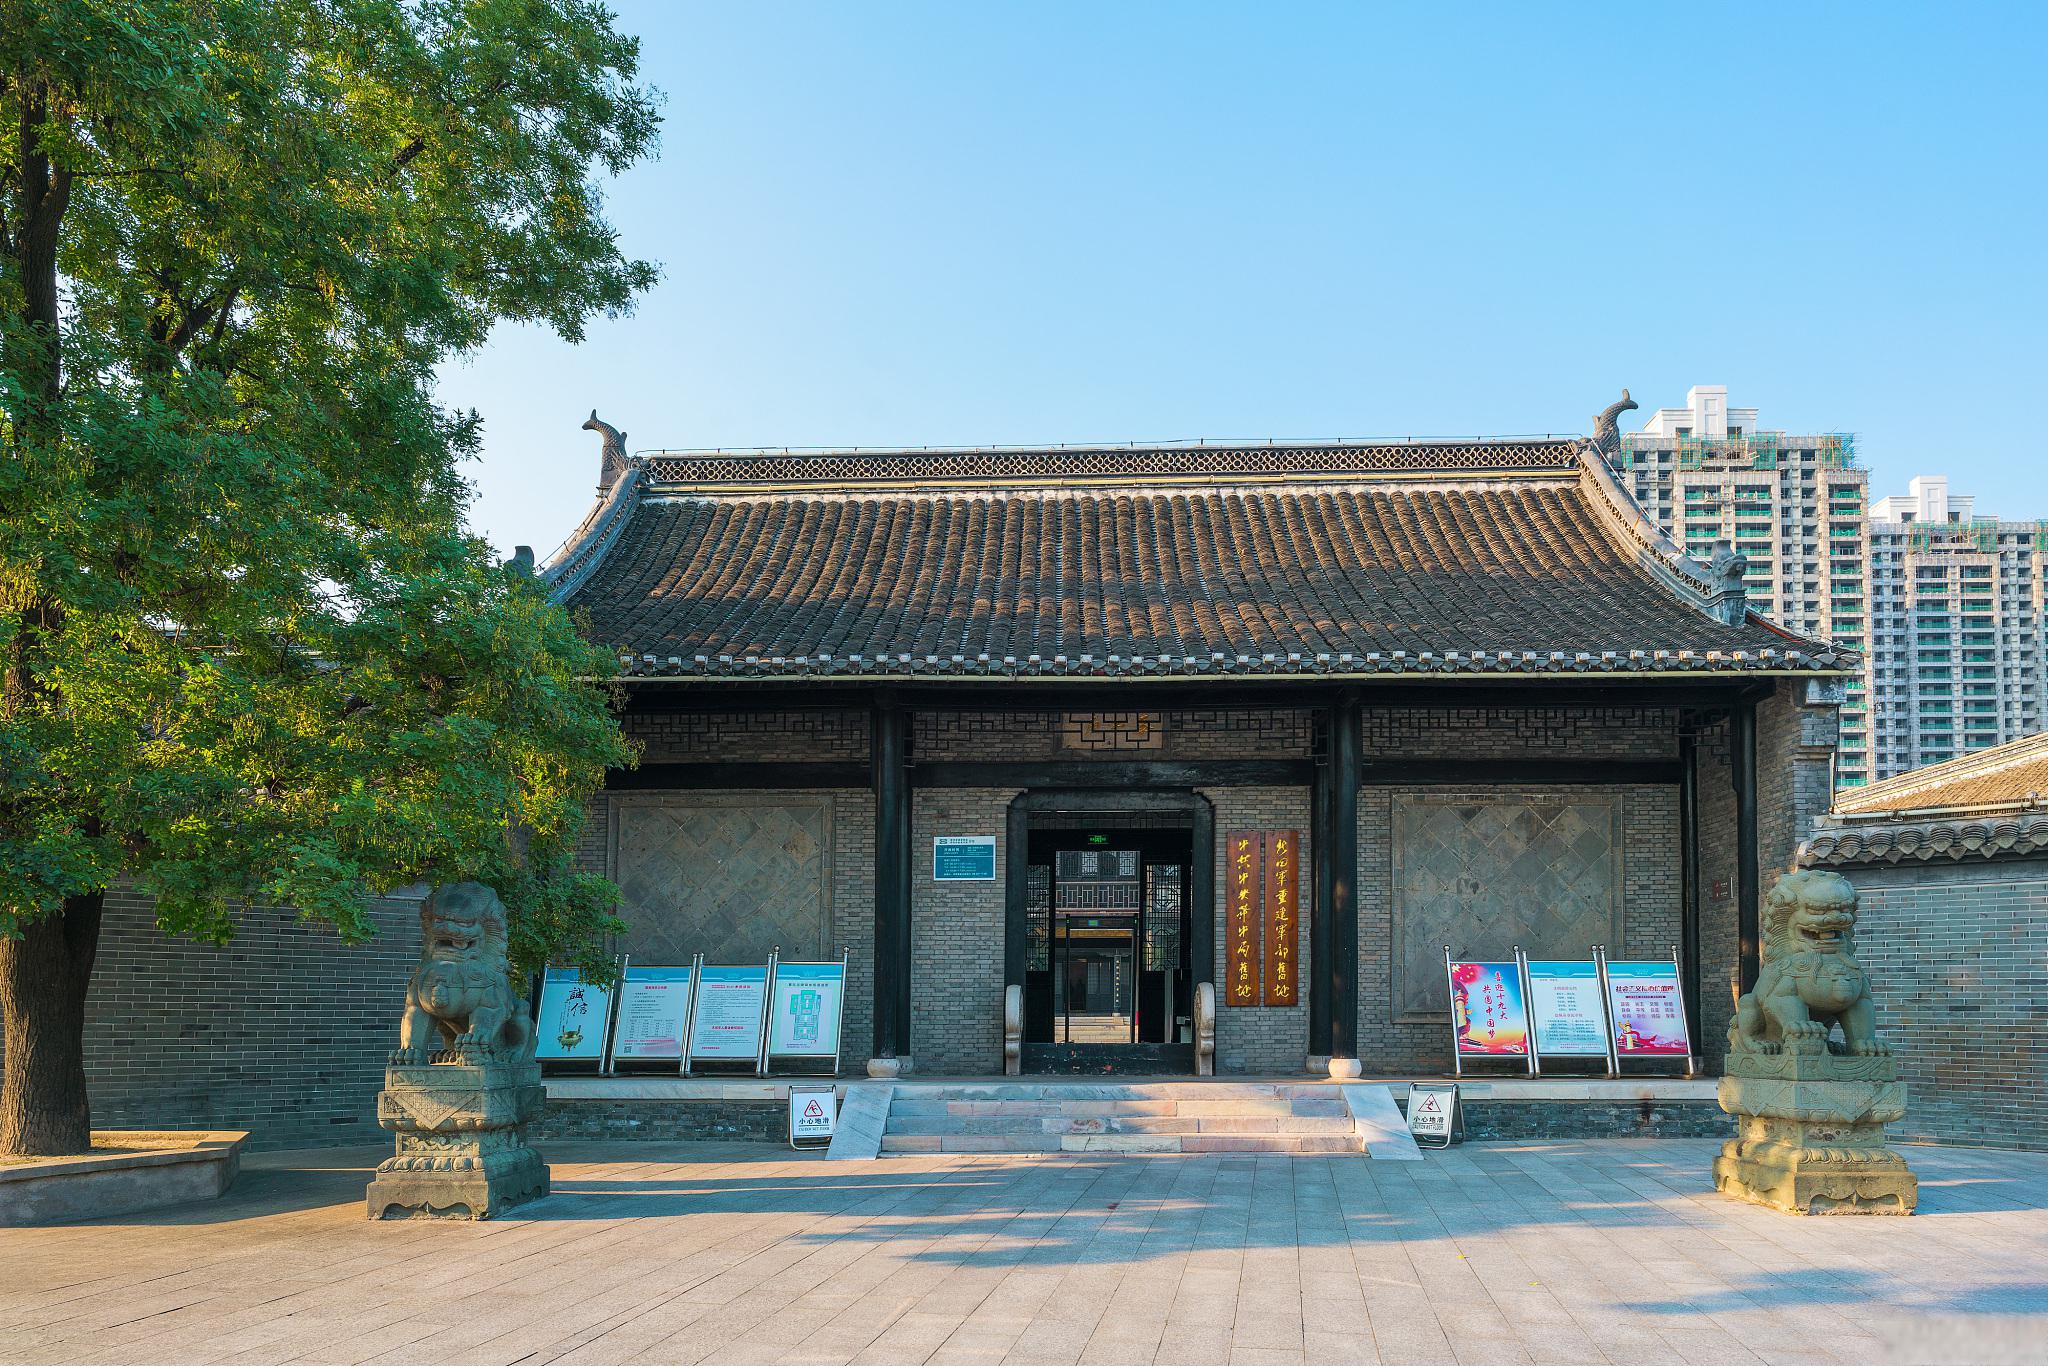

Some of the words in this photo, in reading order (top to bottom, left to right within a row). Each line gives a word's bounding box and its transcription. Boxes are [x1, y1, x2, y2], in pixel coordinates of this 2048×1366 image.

[1495, 971, 1508, 1020] 喜迎十九大
